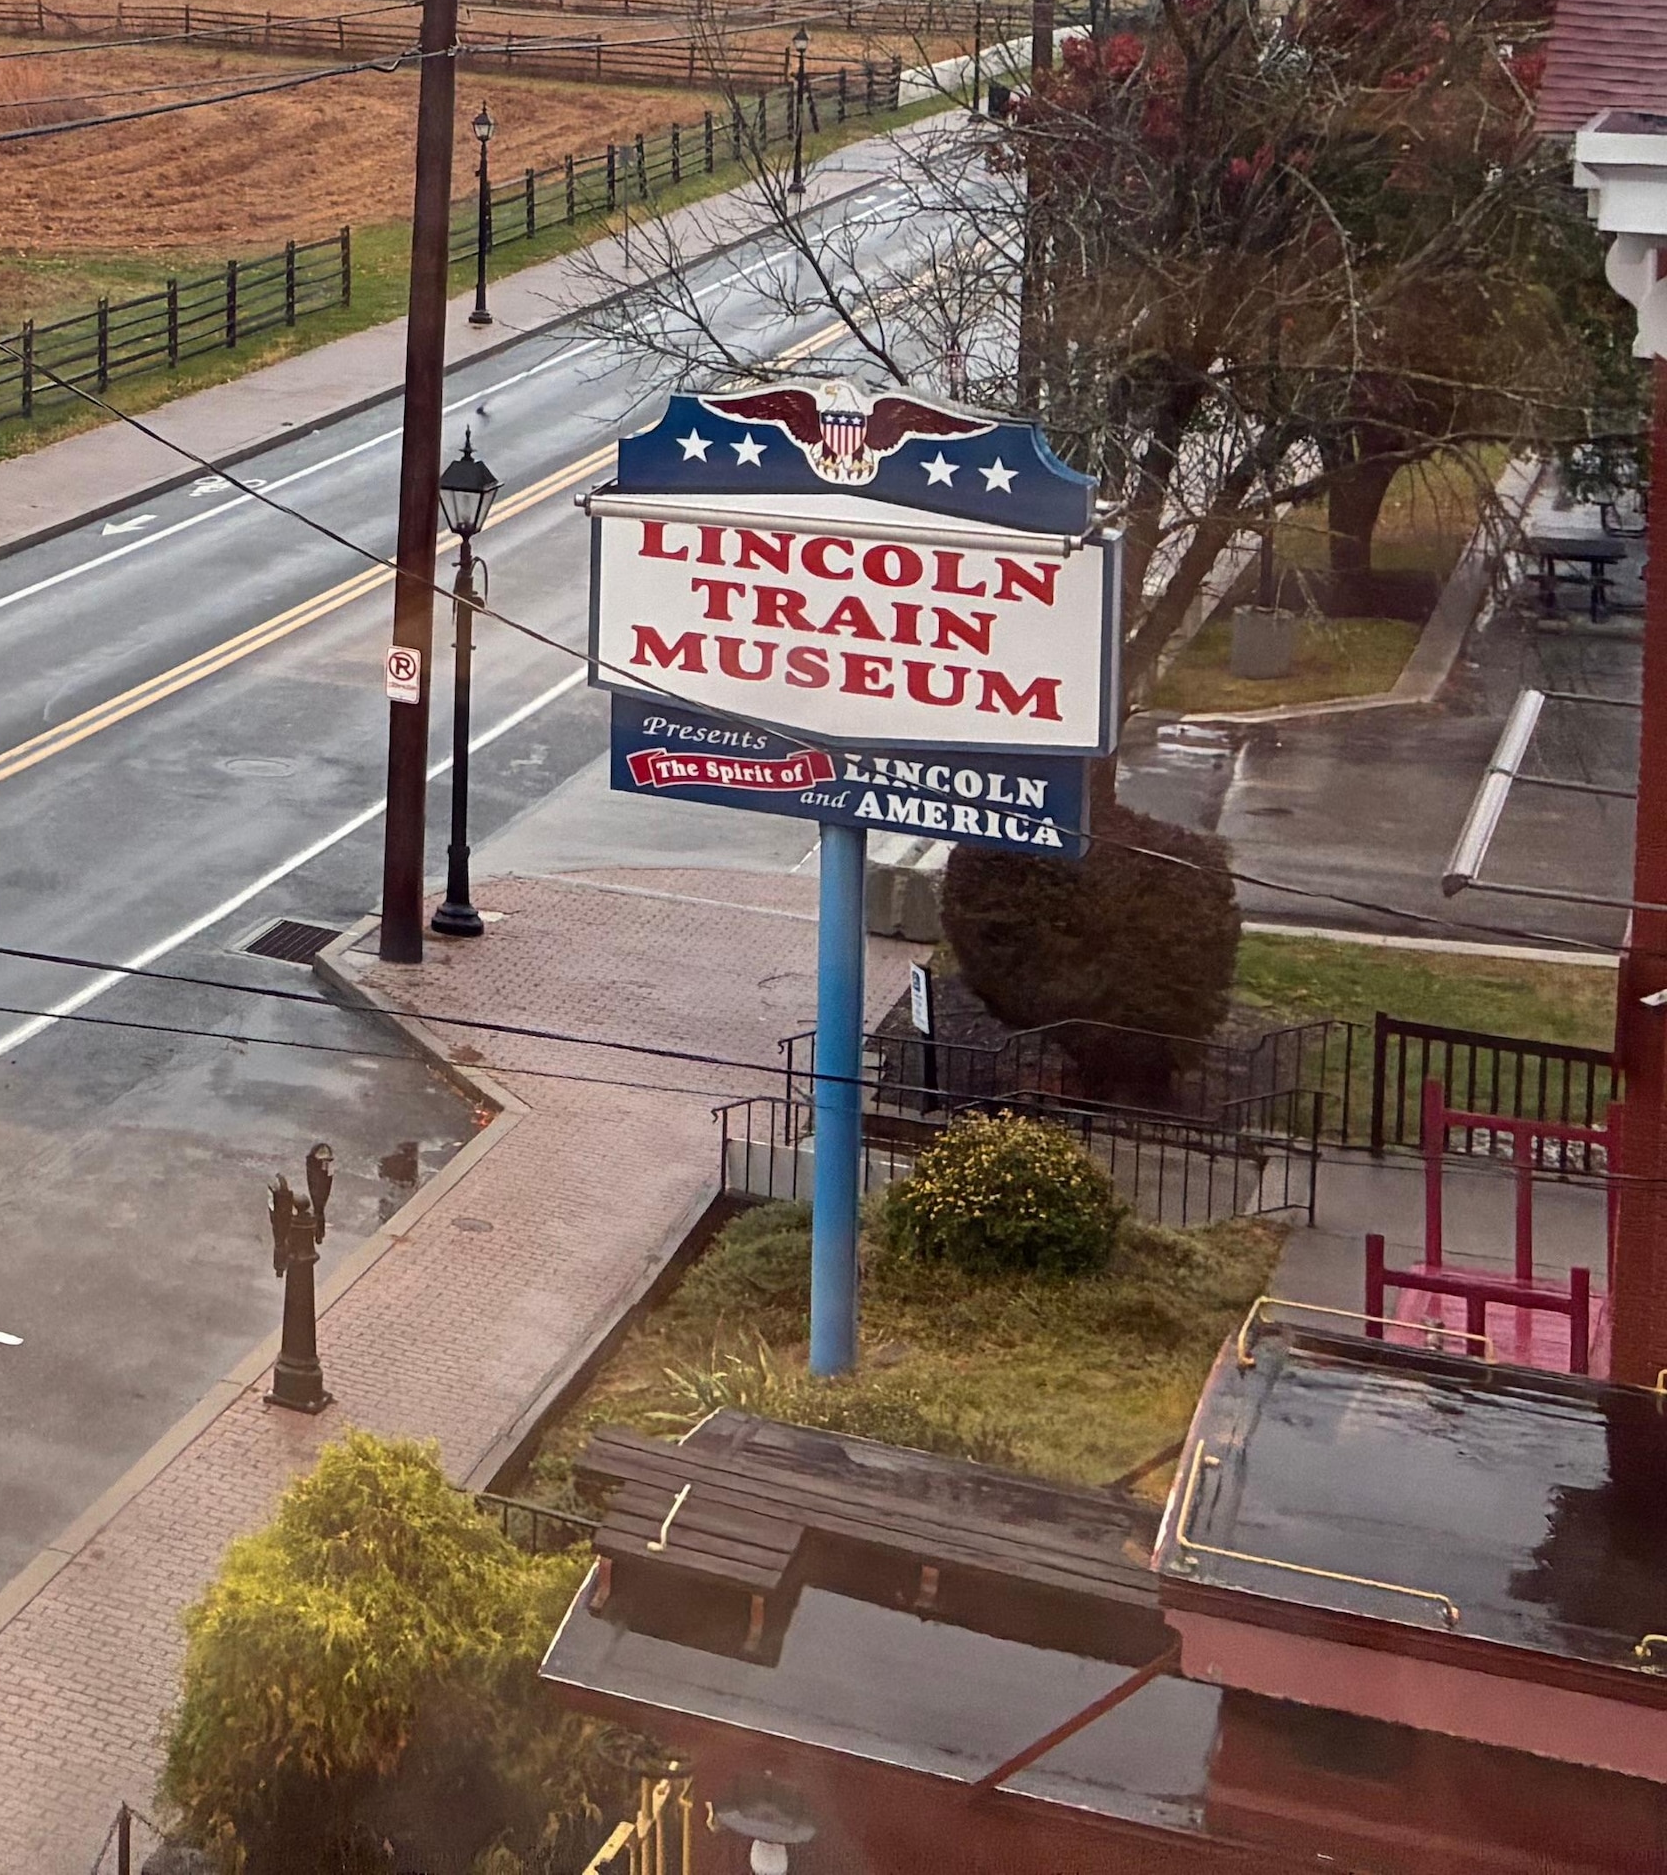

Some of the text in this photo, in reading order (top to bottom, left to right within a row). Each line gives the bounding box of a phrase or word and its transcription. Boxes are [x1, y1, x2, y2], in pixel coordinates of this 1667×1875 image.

[638, 521, 1061, 607] LINCOLN
[691, 578, 997, 655] TRAIN
[629, 624, 1063, 722] MUSEUM
[642, 716, 768, 750] Presents
[656, 760, 803, 785] The Spirit of
[843, 753, 1048, 809] LINCOLN
[800, 790, 1063, 848] and AMERICA
